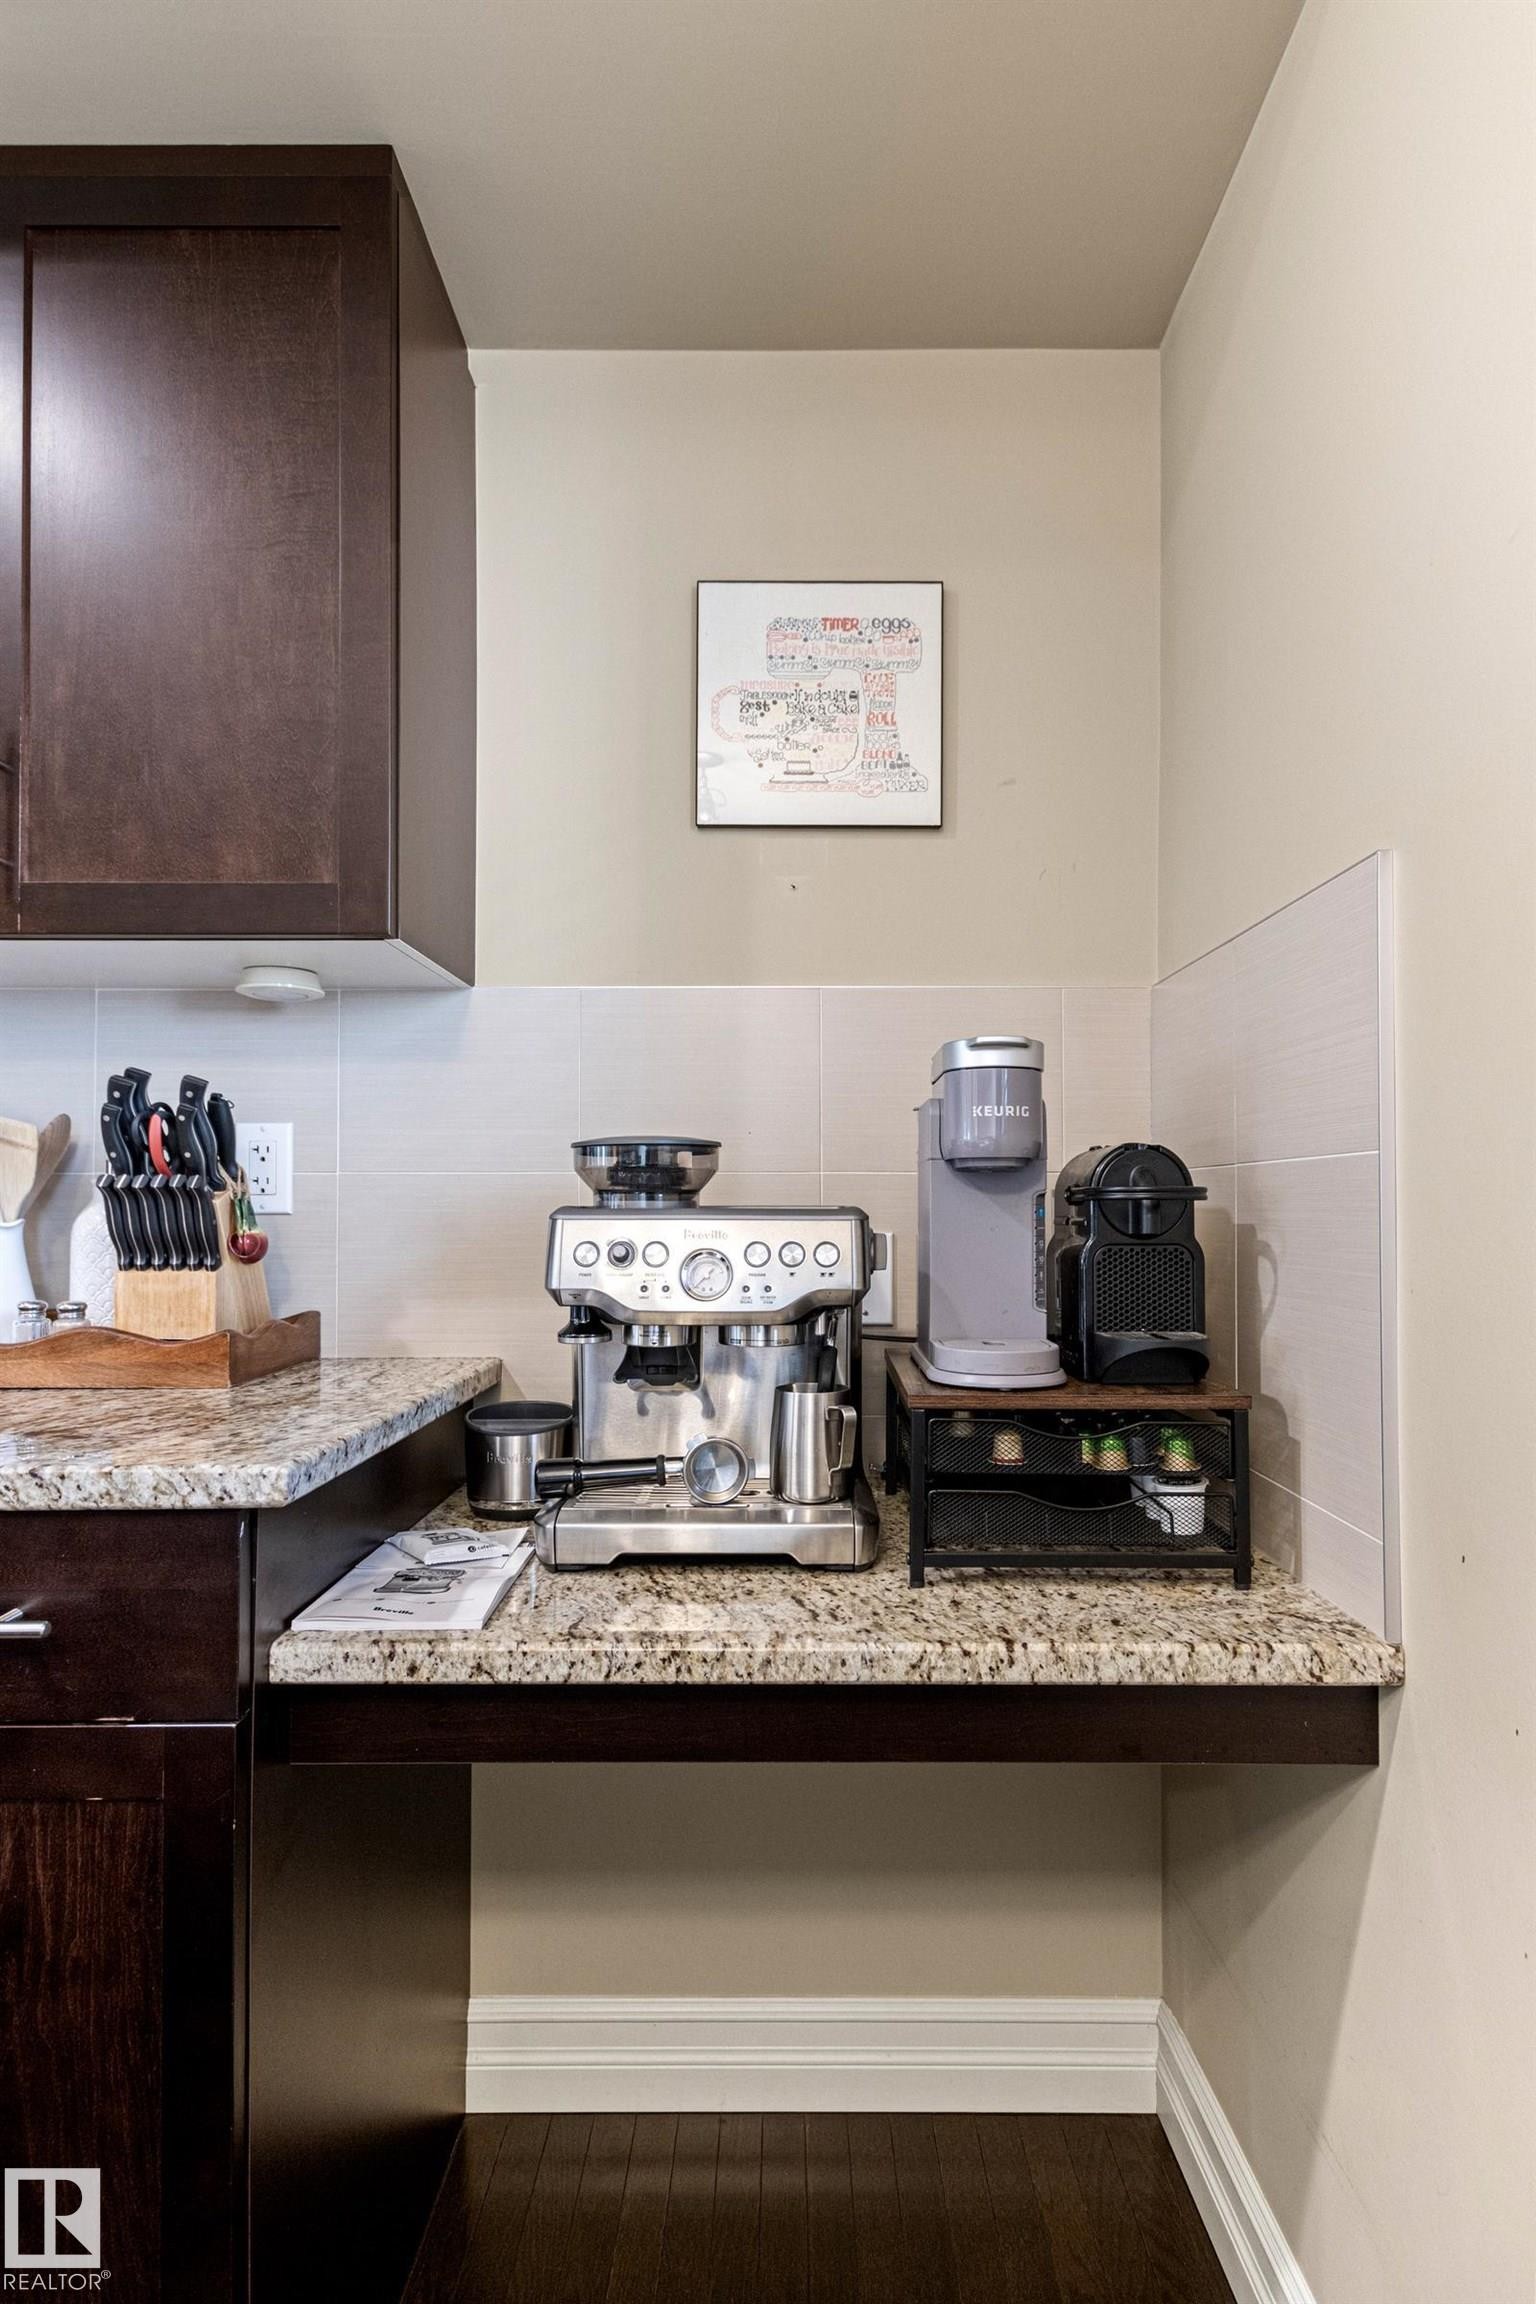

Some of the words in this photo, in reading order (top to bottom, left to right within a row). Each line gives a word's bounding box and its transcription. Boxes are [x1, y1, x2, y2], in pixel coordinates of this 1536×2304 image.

[871, 617, 911, 634] eggs
[785, 700, 817, 716] Bake
[867, 711, 897, 727] ROLL
[972, 1105, 1030, 1117] KEURIG
[373, 1605, 415, 1616] Breville
